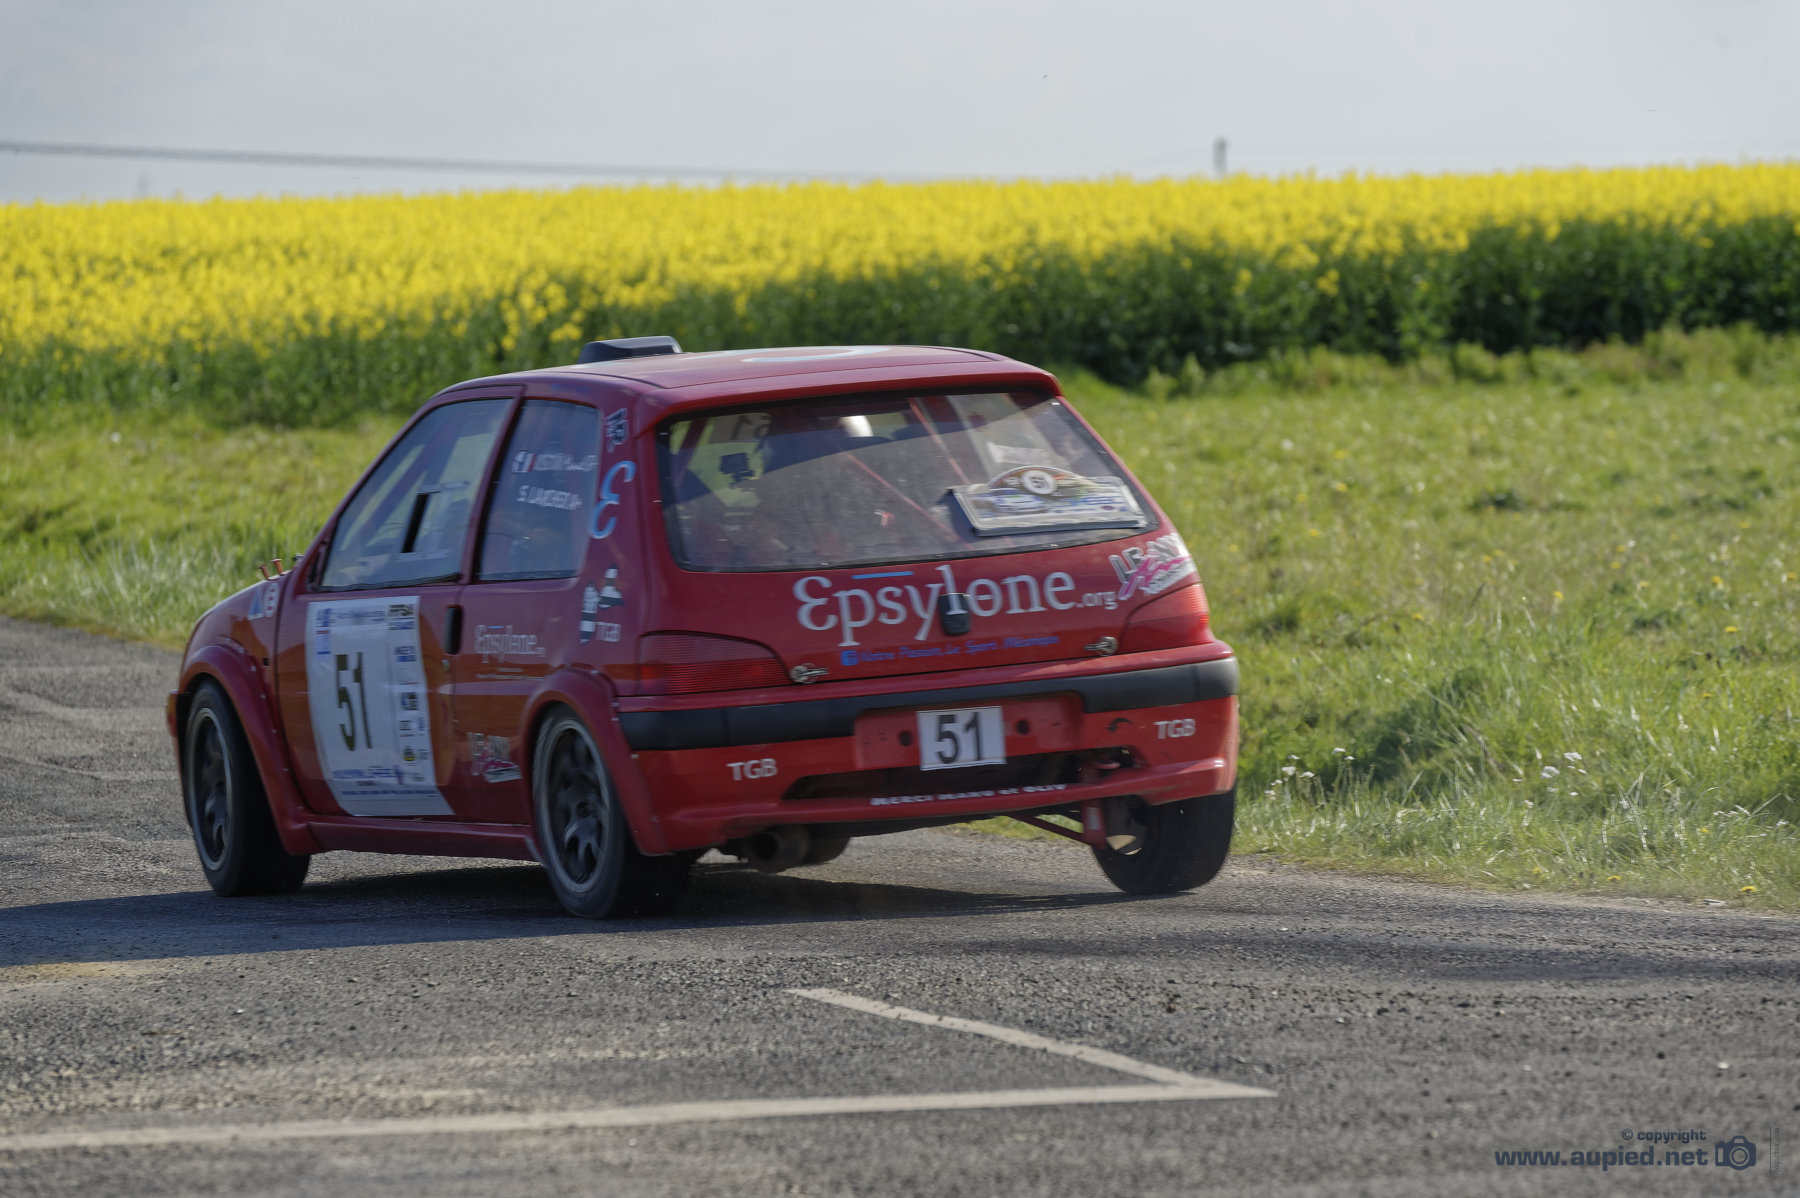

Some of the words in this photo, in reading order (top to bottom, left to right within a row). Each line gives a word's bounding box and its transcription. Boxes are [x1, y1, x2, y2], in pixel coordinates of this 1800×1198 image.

[335, 652, 373, 751] 51
[935, 710, 984, 765] 51
[1154, 718, 1196, 739] TGB
[726, 758, 777, 781] TGB
